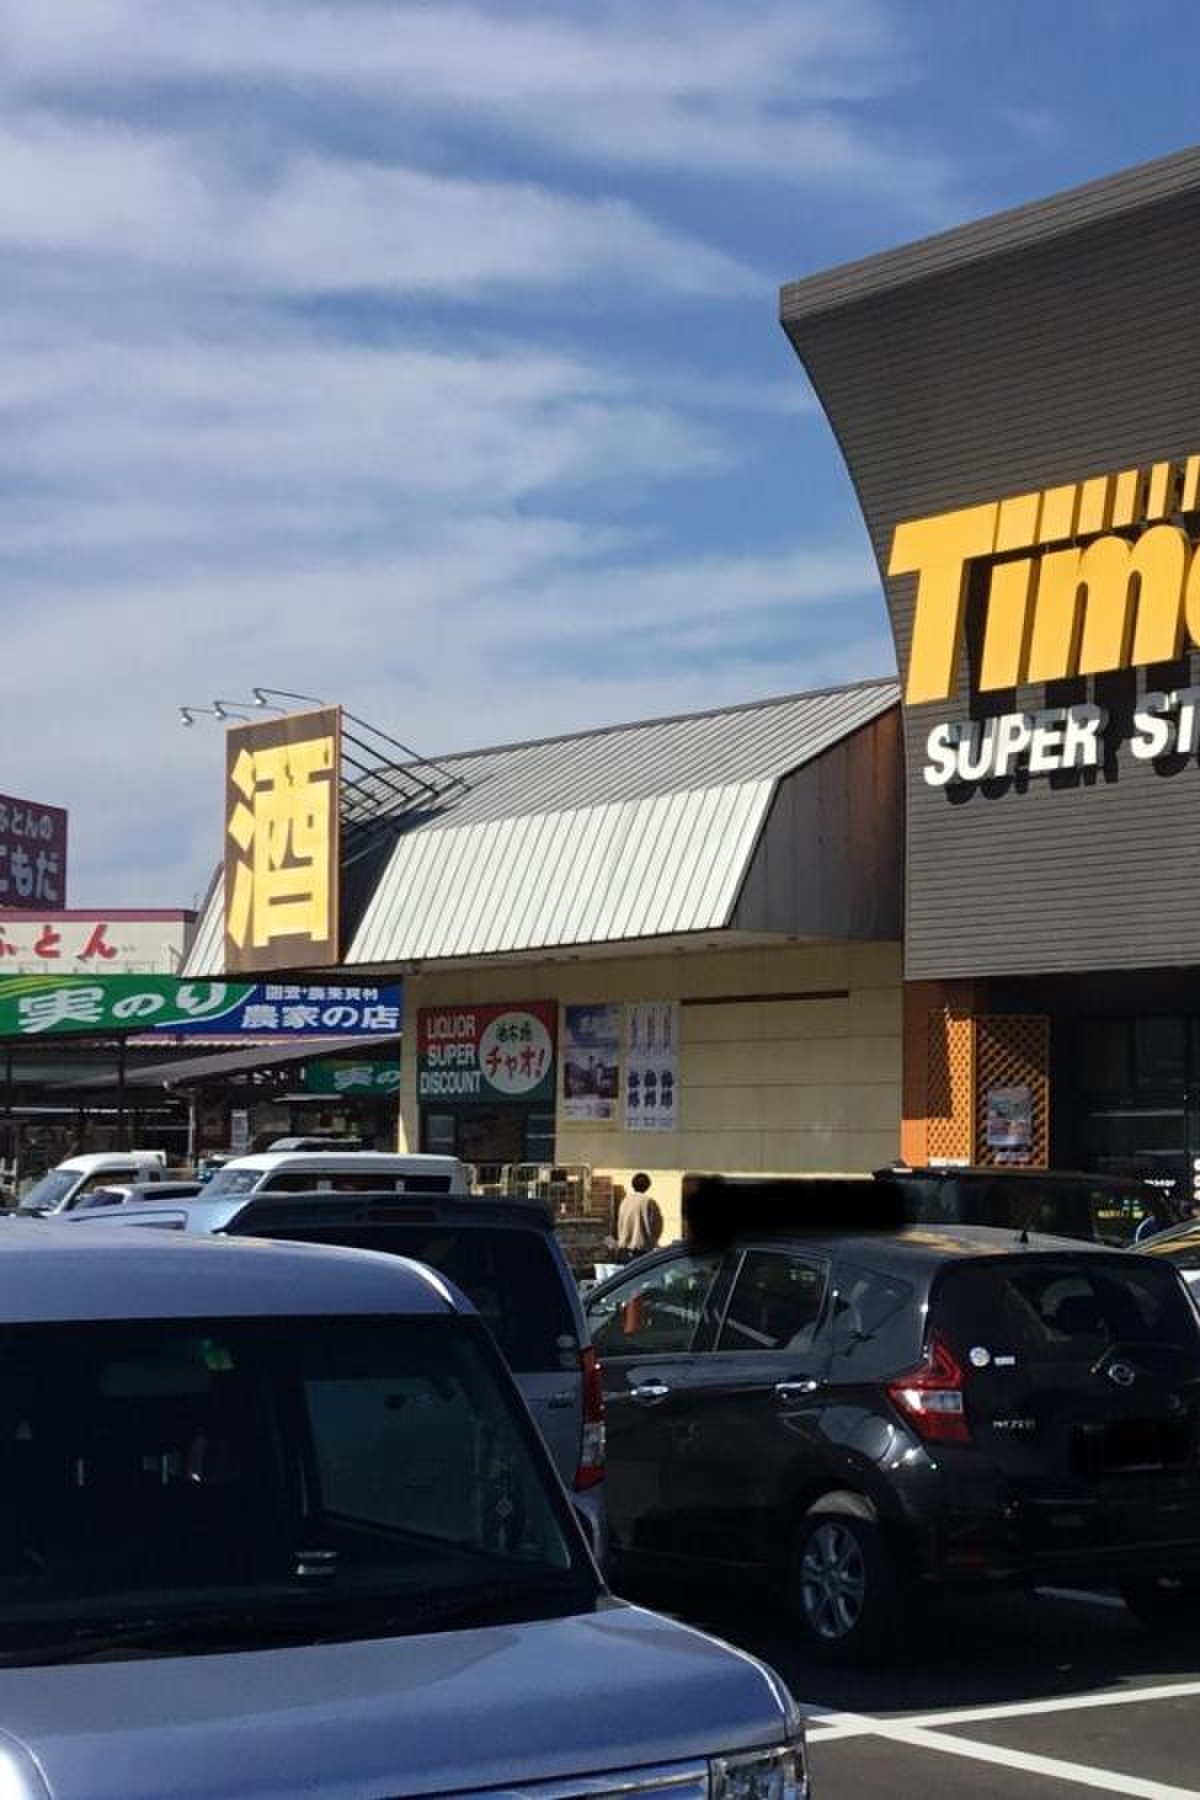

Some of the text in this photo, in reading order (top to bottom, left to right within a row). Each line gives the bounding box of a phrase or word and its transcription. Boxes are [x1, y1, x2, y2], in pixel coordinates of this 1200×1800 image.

[923, 703, 1103, 787] SUPER
[228, 736, 335, 949] 酒
[18, 983, 229, 1033] 実のり
[240, 1004, 400, 1029] 農家の店
[426, 1014, 476, 1039] LIQUOR
[427, 1043, 476, 1067] SUPER
[419, 1071, 481, 1095] DISCOUNT
